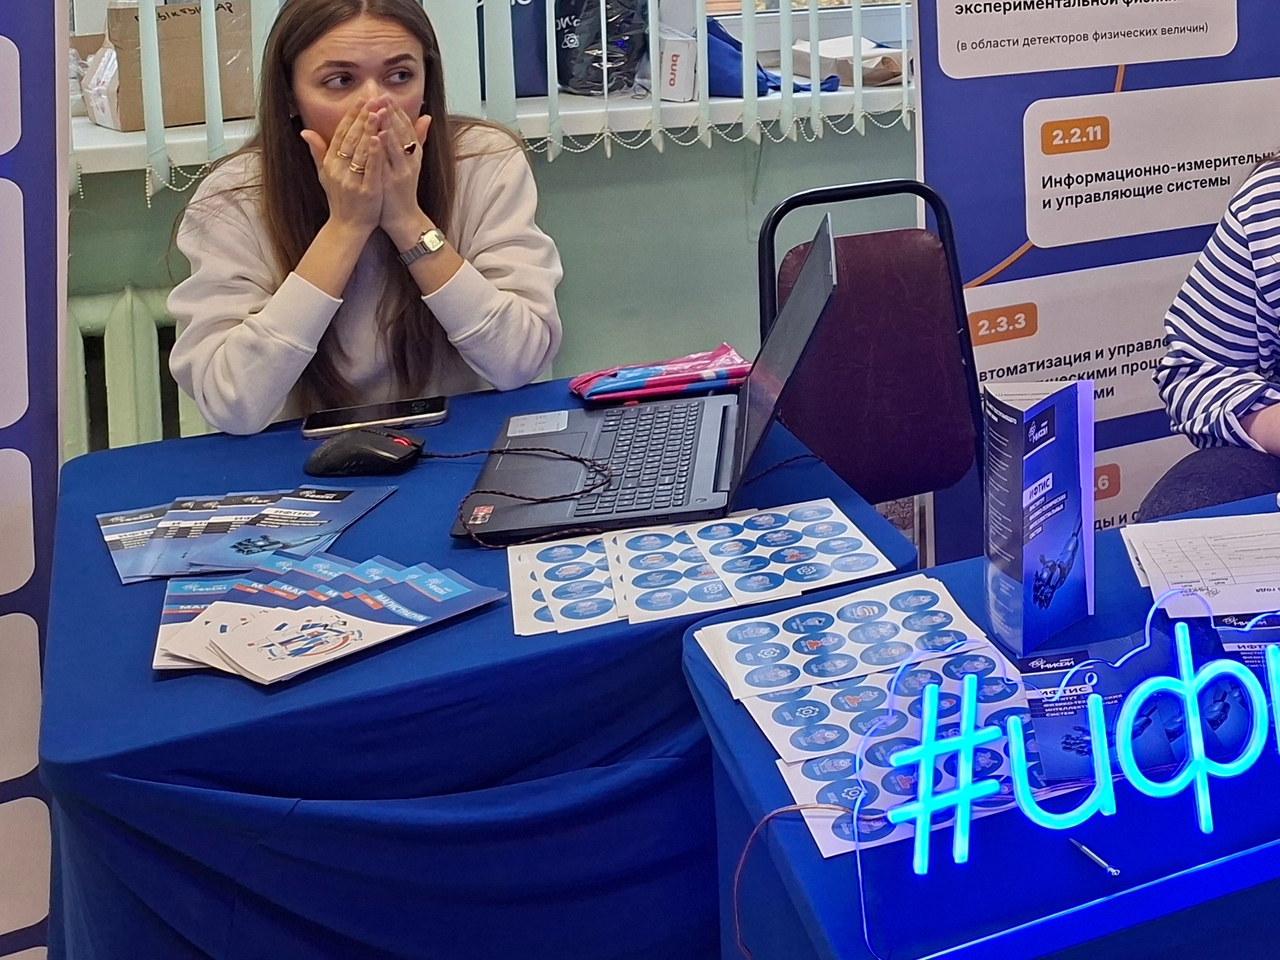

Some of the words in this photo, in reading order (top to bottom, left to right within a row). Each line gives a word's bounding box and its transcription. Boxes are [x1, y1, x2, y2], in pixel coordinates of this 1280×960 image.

[956, 38, 969, 53] (в
[971, 34, 1019, 52] области
[1022, 31, 1090, 49] детекторов
[1092, 26, 1158, 44] физических
[1160, 22, 1209, 39] величин)
[668, 53, 680, 87] buro
[1052, 124, 1102, 145] 2.2.11
[1042, 198, 1052, 209] и
[1055, 187, 1162, 208] управляющие
[1167, 175, 1231, 193] системы
[977, 312, 1027, 337] 2.3.3
[979, 348, 1092, 383] втоматизация
[1095, 348, 1104, 361] и
[1028, 477, 1051, 500] ИФТИС
[1255, 585, 1276, 594] года
